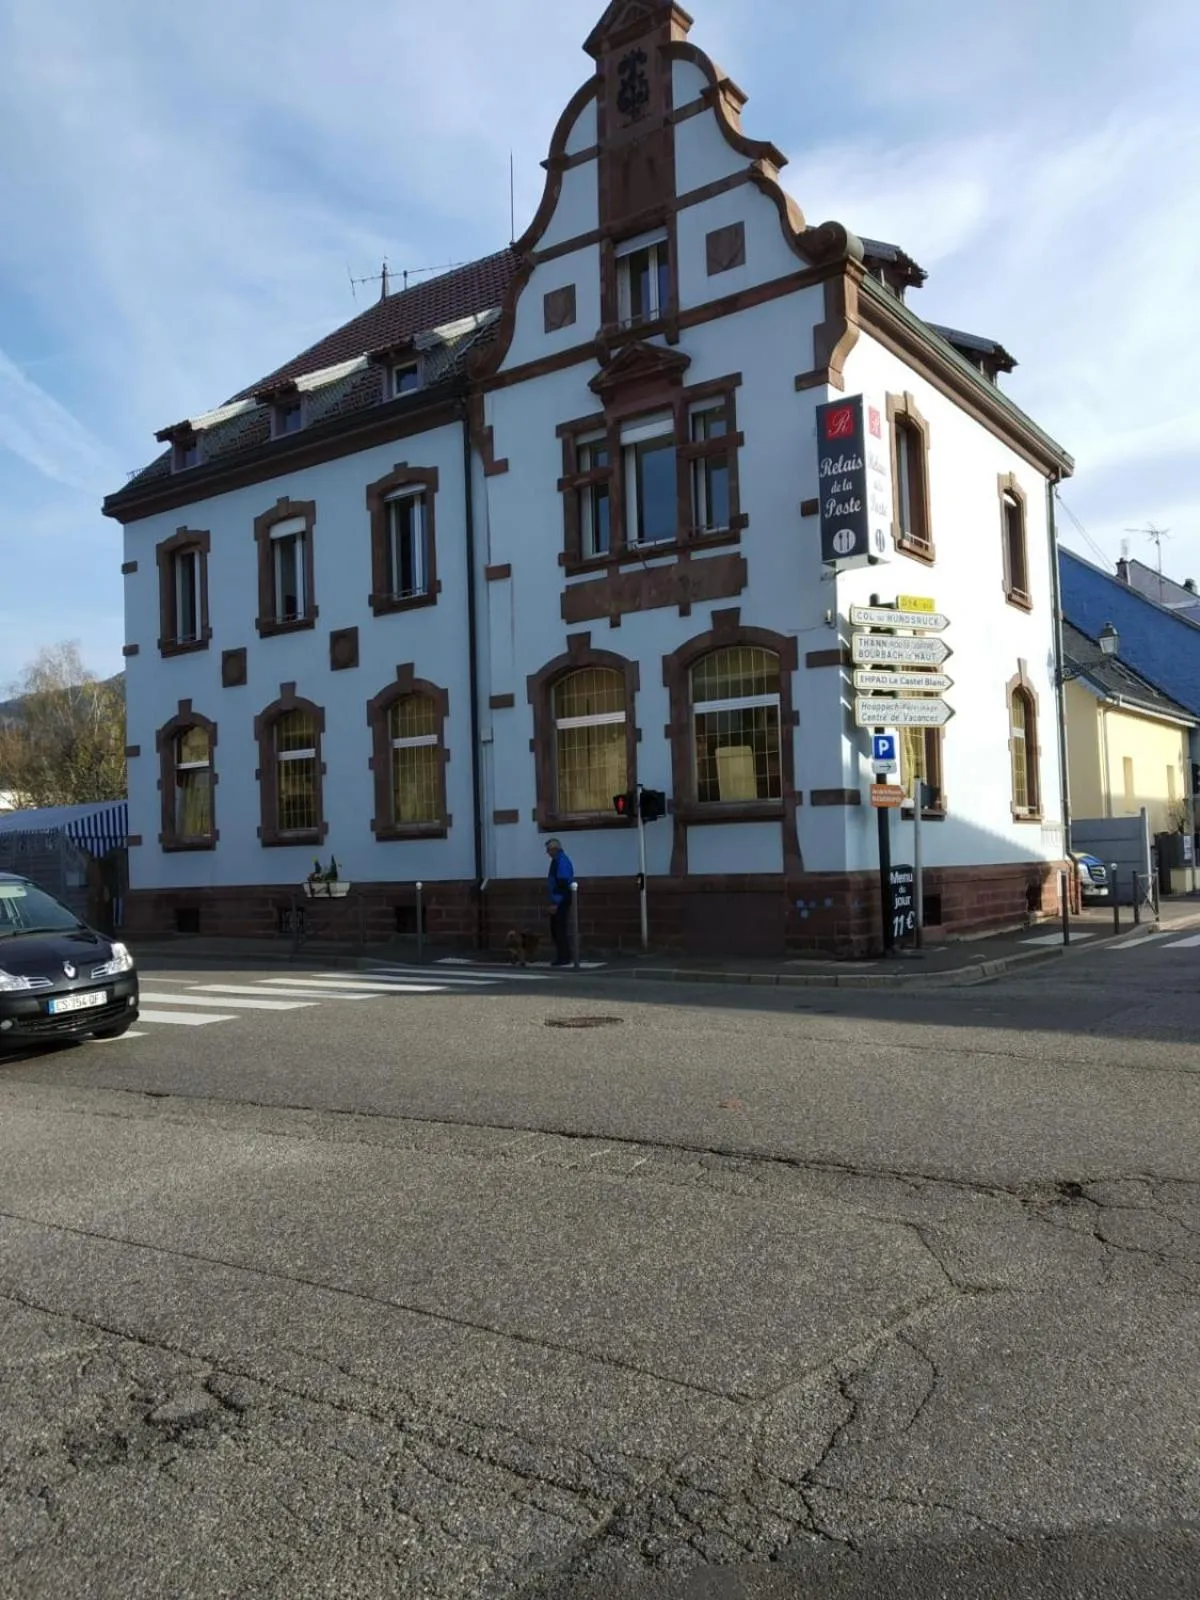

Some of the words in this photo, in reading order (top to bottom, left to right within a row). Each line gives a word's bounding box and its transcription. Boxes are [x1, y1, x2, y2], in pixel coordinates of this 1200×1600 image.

[820, 454, 863, 477] Relais
[831, 480, 841, 494] de
[843, 478, 852, 490] la
[825, 499, 861, 519] Poste
[856, 611, 874, 621] COL
[858, 638, 887, 648] THANN
[858, 648, 903, 659] BOURBACH
[914, 651, 937, 661] HAUT
[860, 675, 887, 685] EHPAD
[900, 677, 923, 686] Castel
[925, 677, 945, 687] Blanc
[862, 711, 887, 721] Centre
[890, 711, 899, 721] de
[903, 712, 938, 722] Vacances
[878, 739, 889, 756] P
[890, 871, 913, 884] Menu
[894, 894, 911, 909] jour
